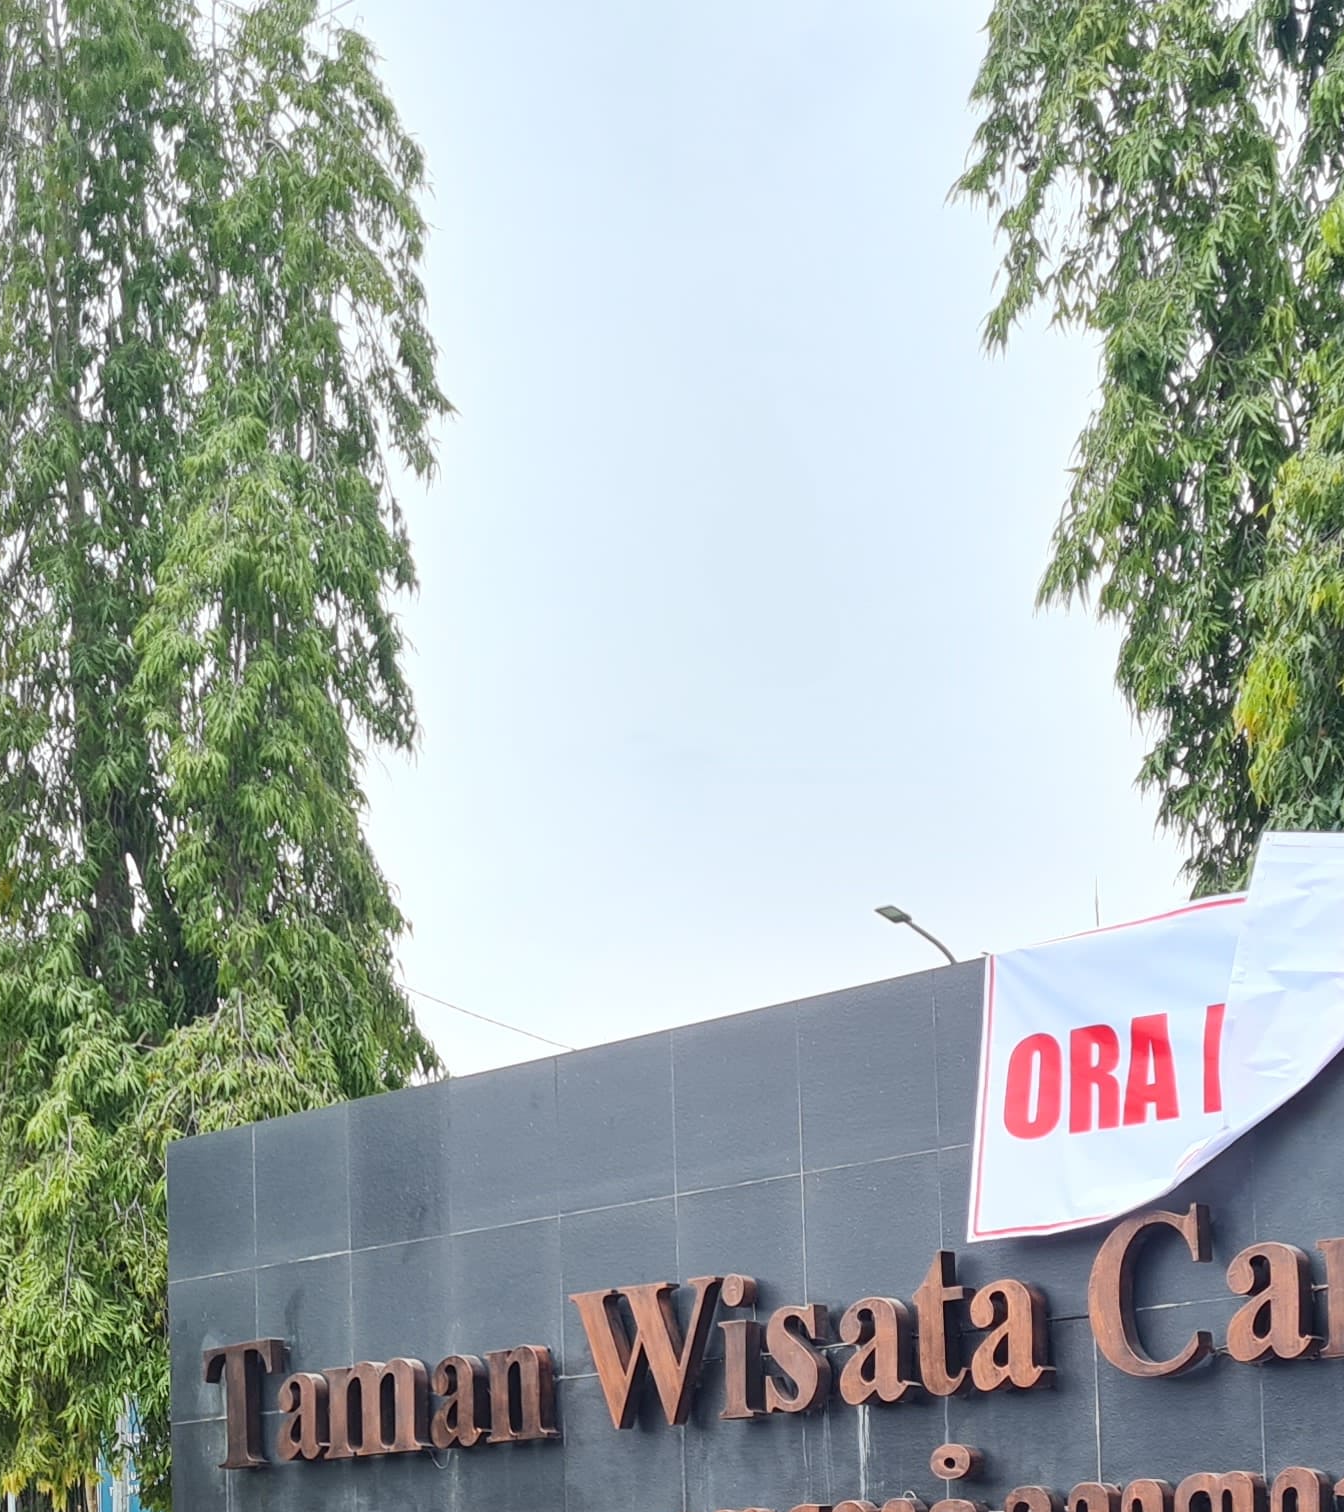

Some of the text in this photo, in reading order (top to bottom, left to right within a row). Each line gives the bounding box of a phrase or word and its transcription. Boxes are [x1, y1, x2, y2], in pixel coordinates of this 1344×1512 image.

[1003, 1013, 1179, 1139] ORA
[203, 1337, 560, 1469] Taman
[569, 1250, 1052, 1430] Wisata
